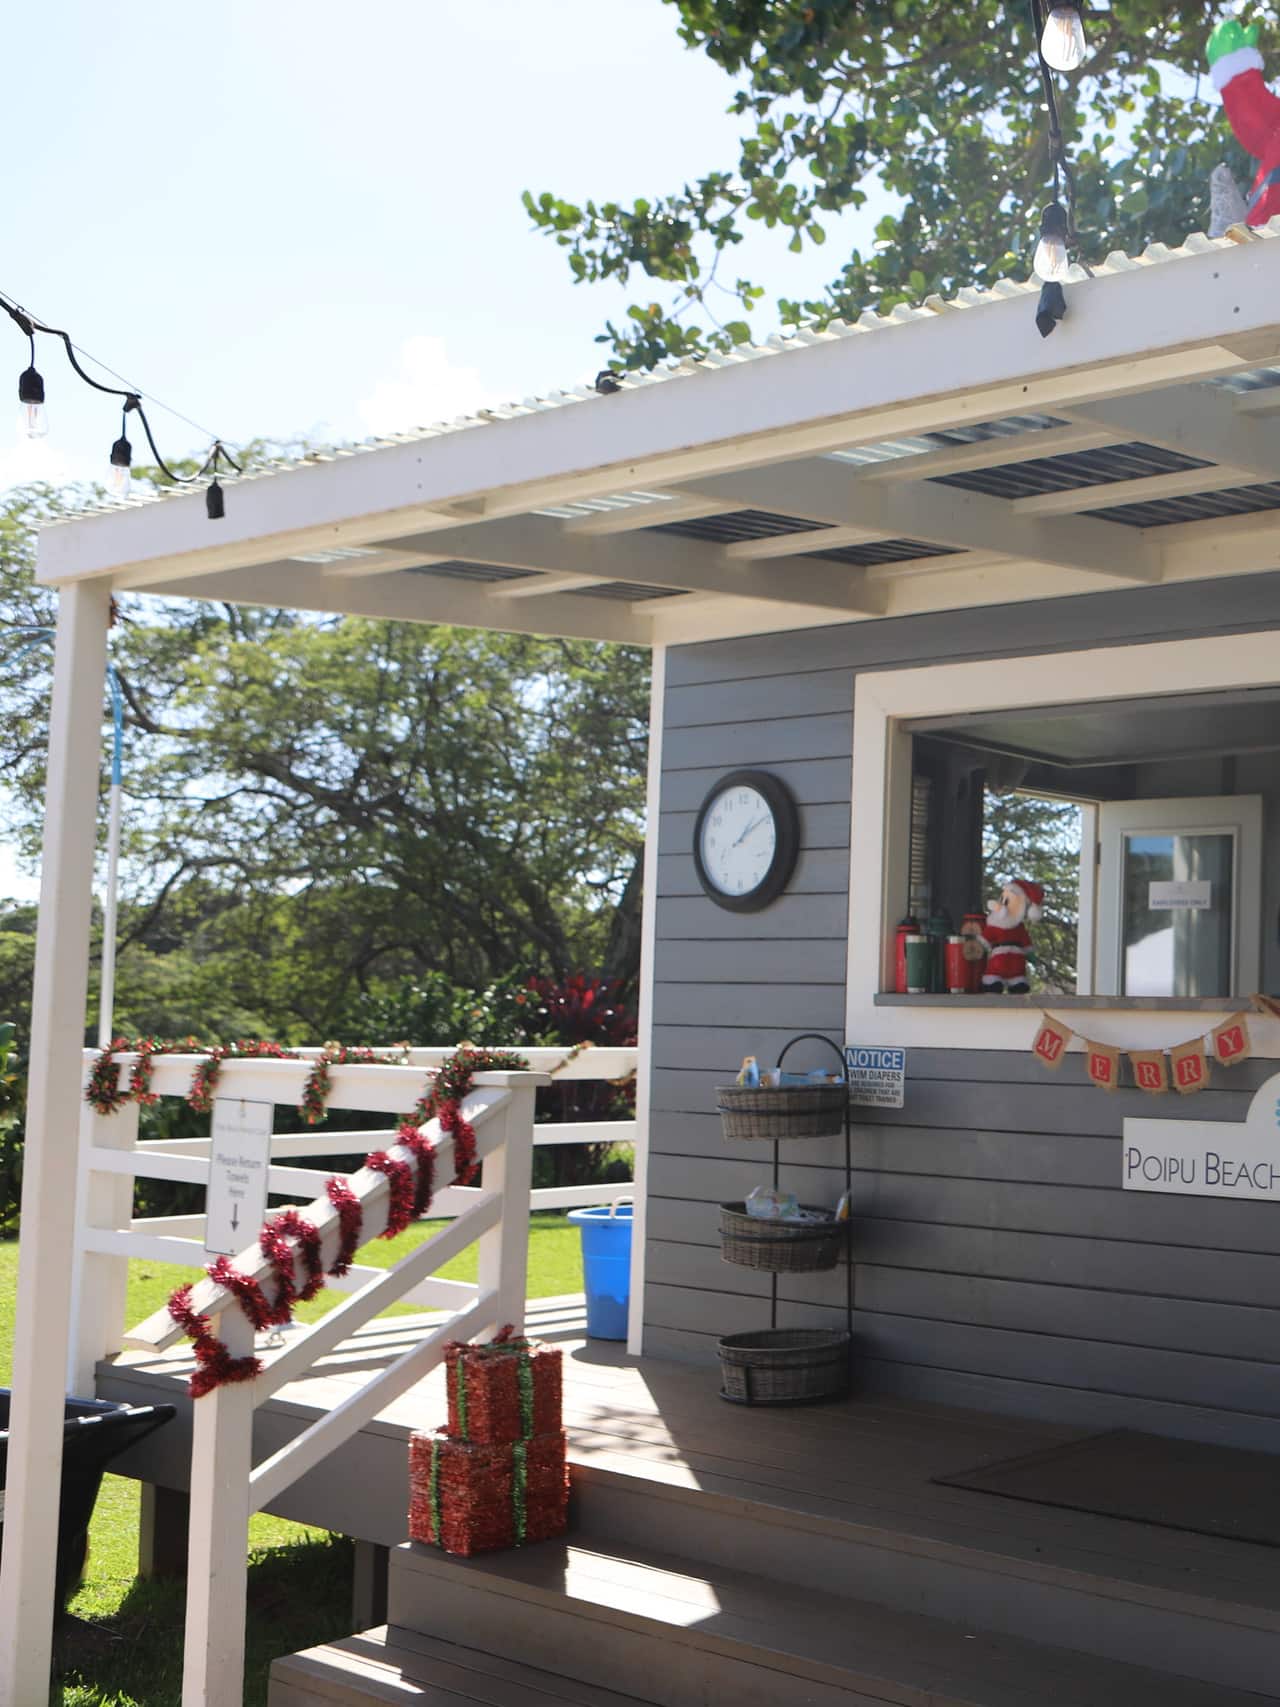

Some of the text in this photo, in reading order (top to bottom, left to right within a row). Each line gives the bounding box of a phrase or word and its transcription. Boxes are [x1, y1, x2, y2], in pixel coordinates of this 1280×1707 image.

[846, 1050, 902, 1068] NOTICE
[1036, 1028, 1243, 1087] MERRY
[848, 1070, 903, 1081] WIM DIAPERS
